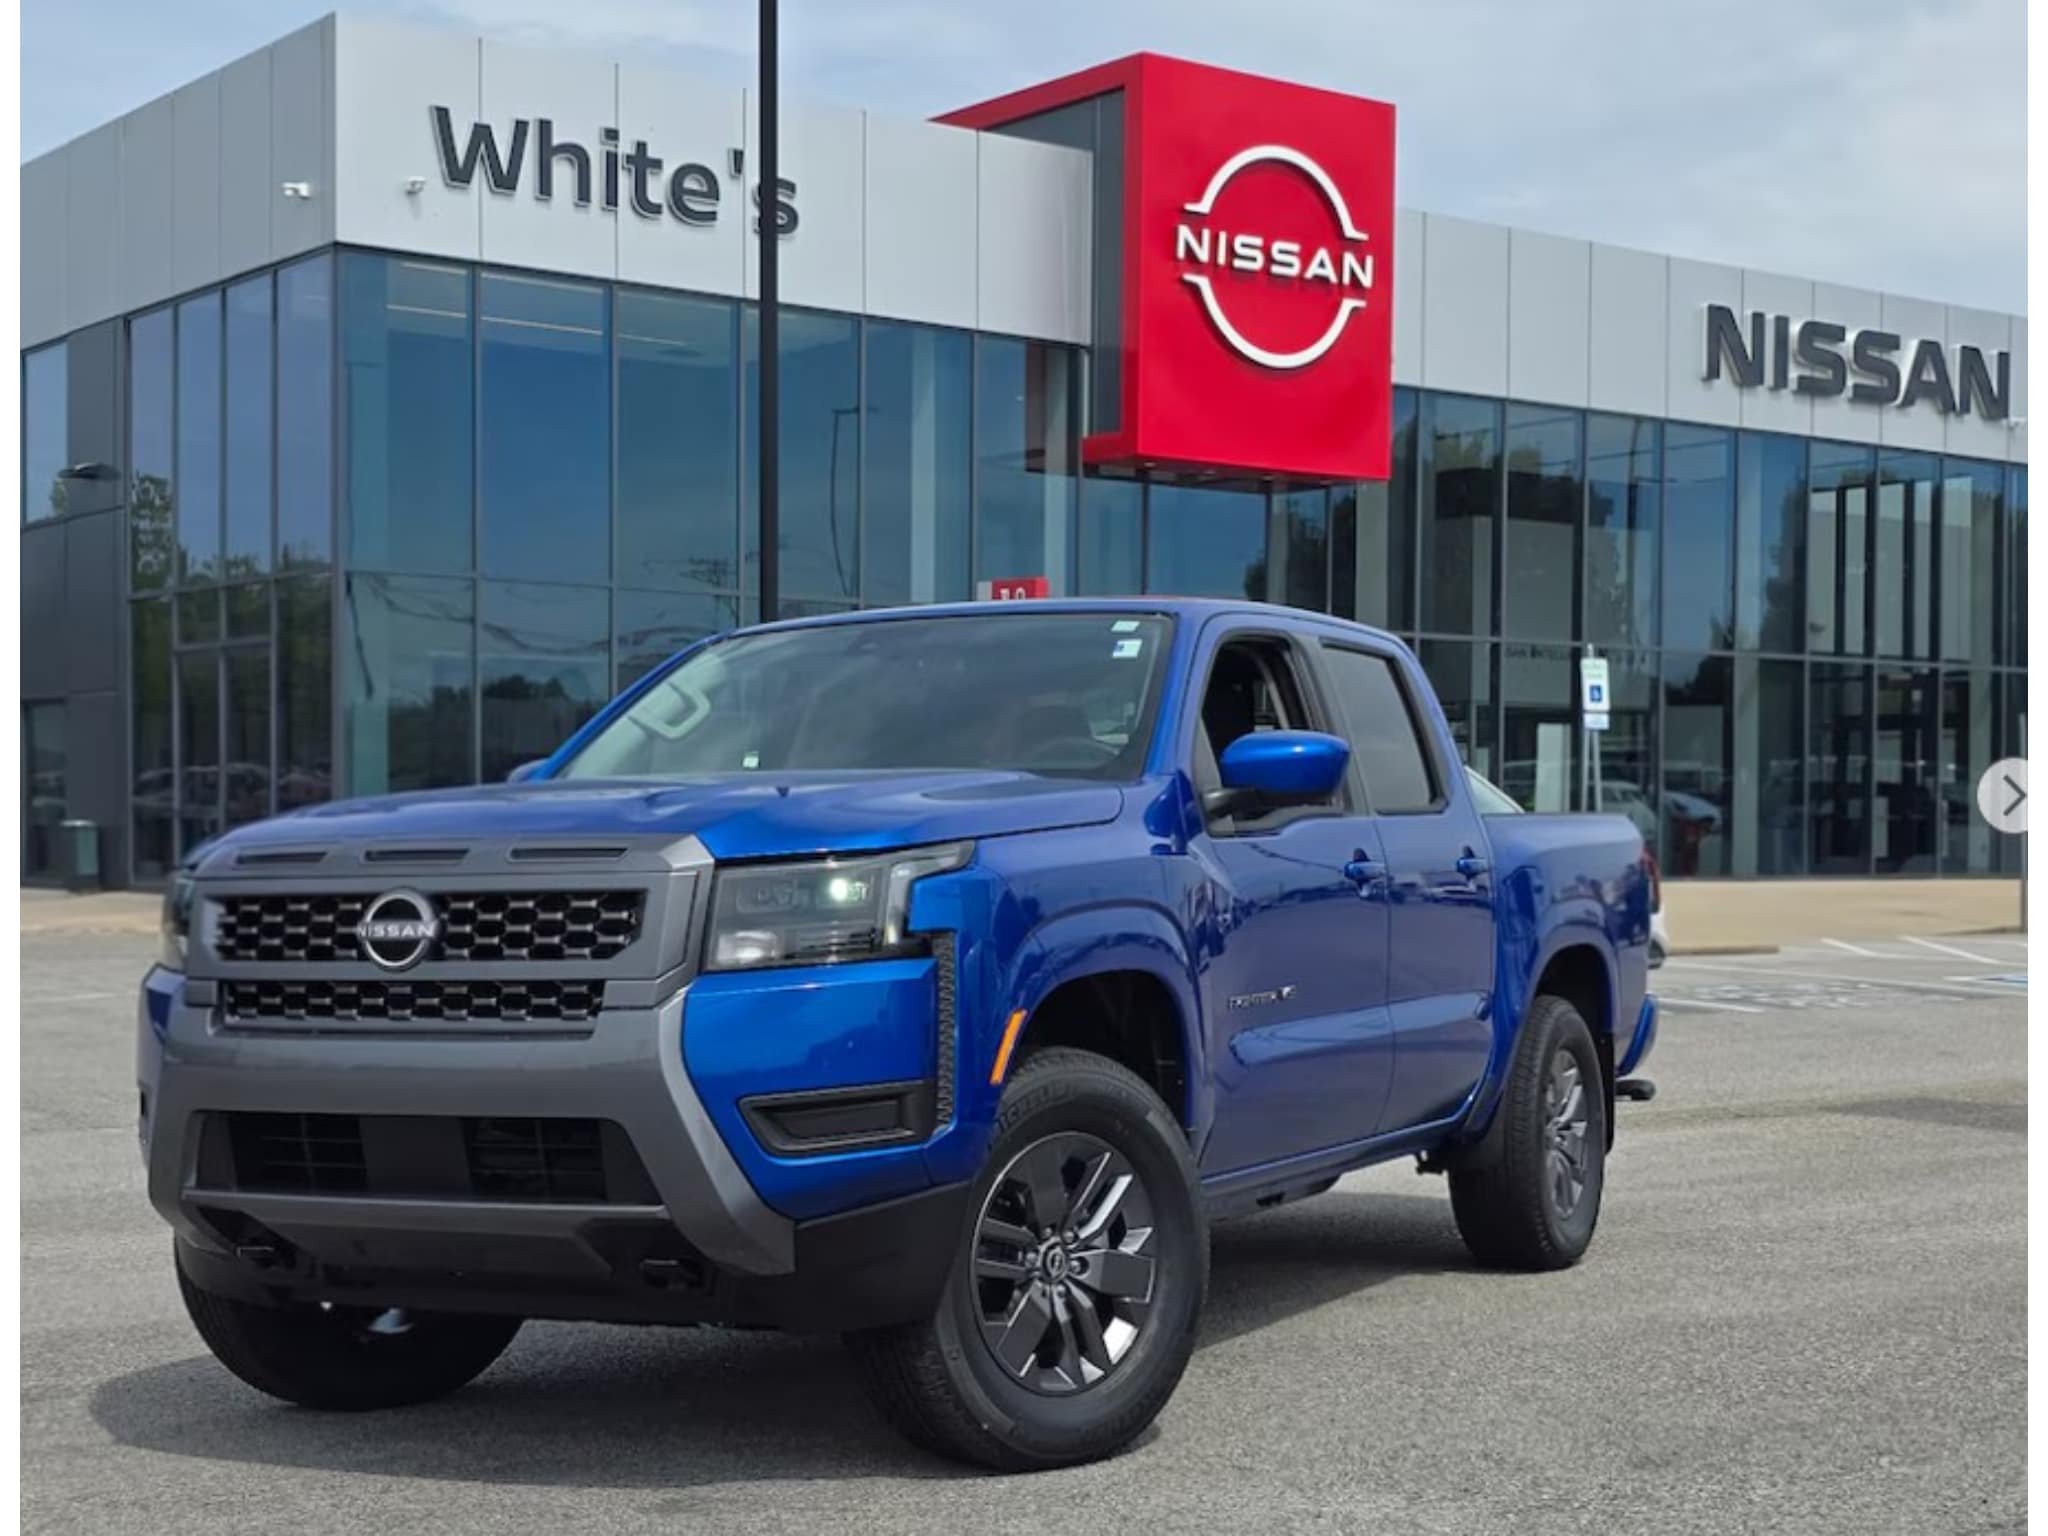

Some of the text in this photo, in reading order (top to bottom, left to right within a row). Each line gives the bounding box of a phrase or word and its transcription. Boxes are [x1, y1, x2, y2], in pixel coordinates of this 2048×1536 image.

[431, 105, 800, 236] White's
[1176, 224, 1374, 289] NISSAN
[1703, 303, 2010, 420] NISSAN
[358, 922, 437, 938] NISSAN
